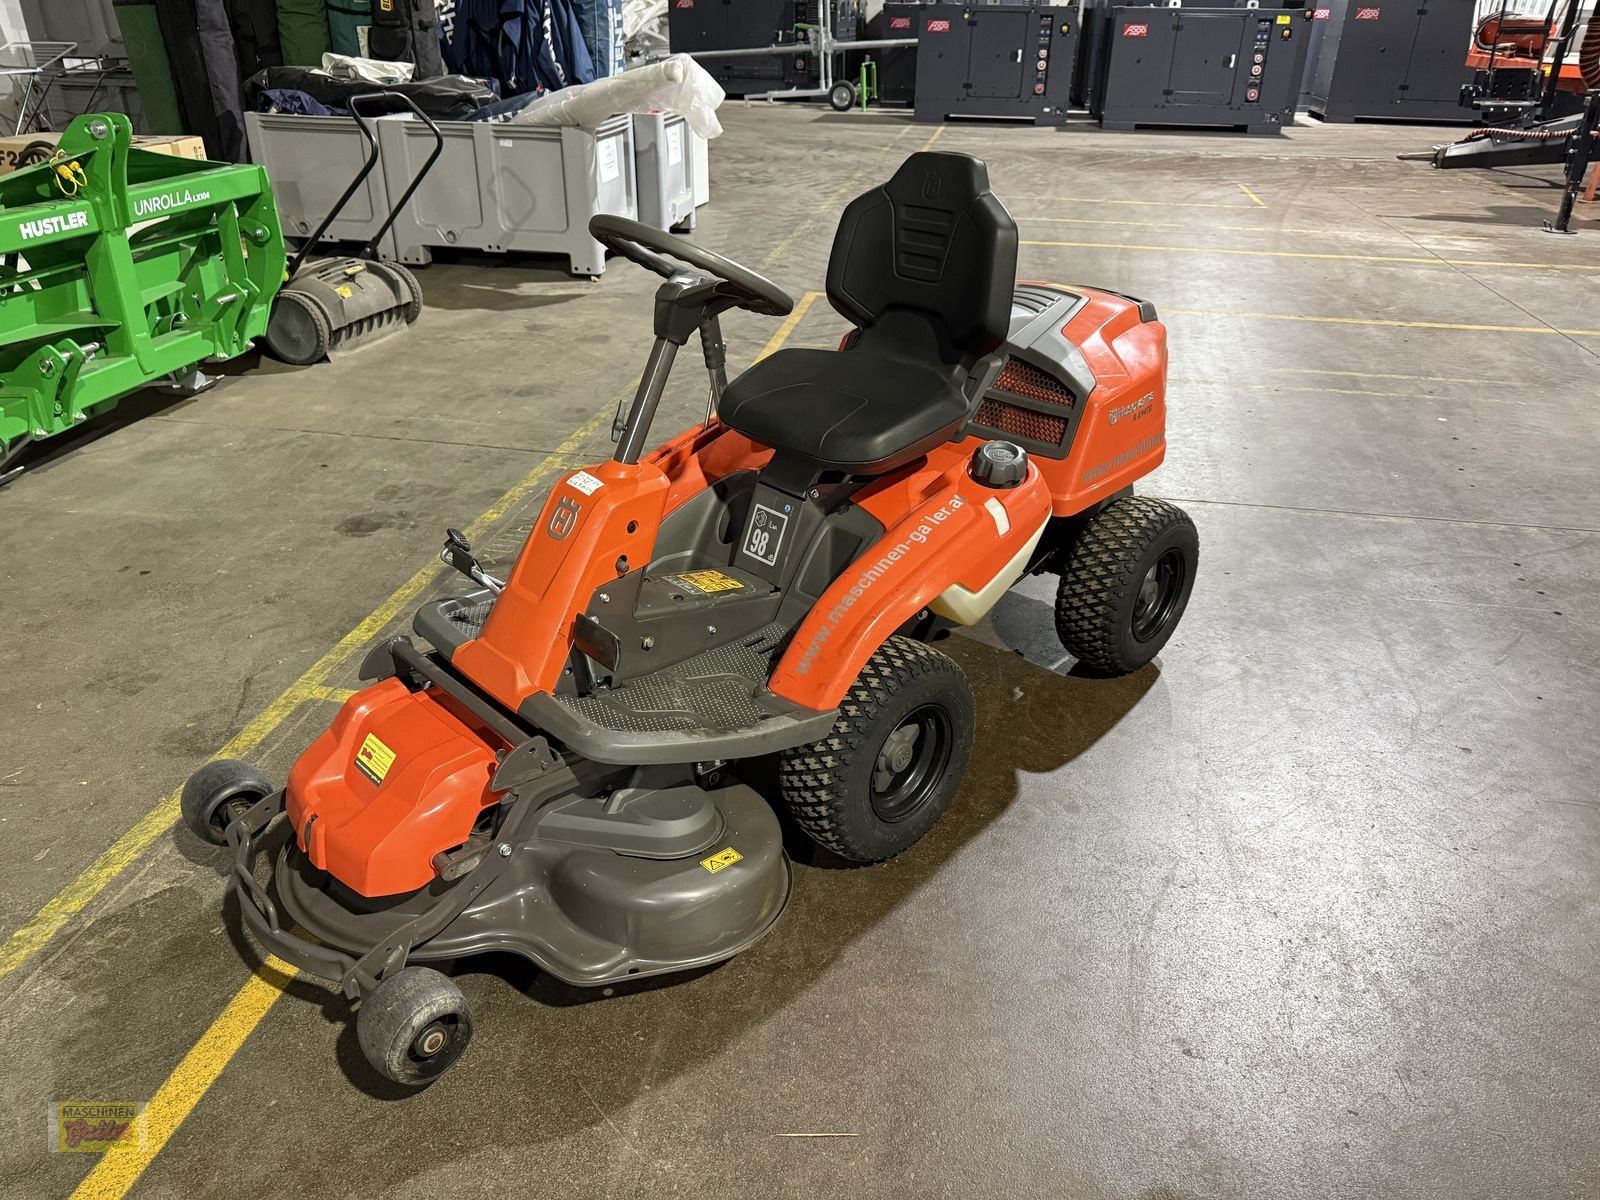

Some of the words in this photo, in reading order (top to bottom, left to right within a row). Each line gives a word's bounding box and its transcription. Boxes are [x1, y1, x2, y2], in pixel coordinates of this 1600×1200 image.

[134, 189, 193, 216] UNROLLA
[19, 212, 89, 241] HUSTLER
[750, 528, 769, 556] 98
